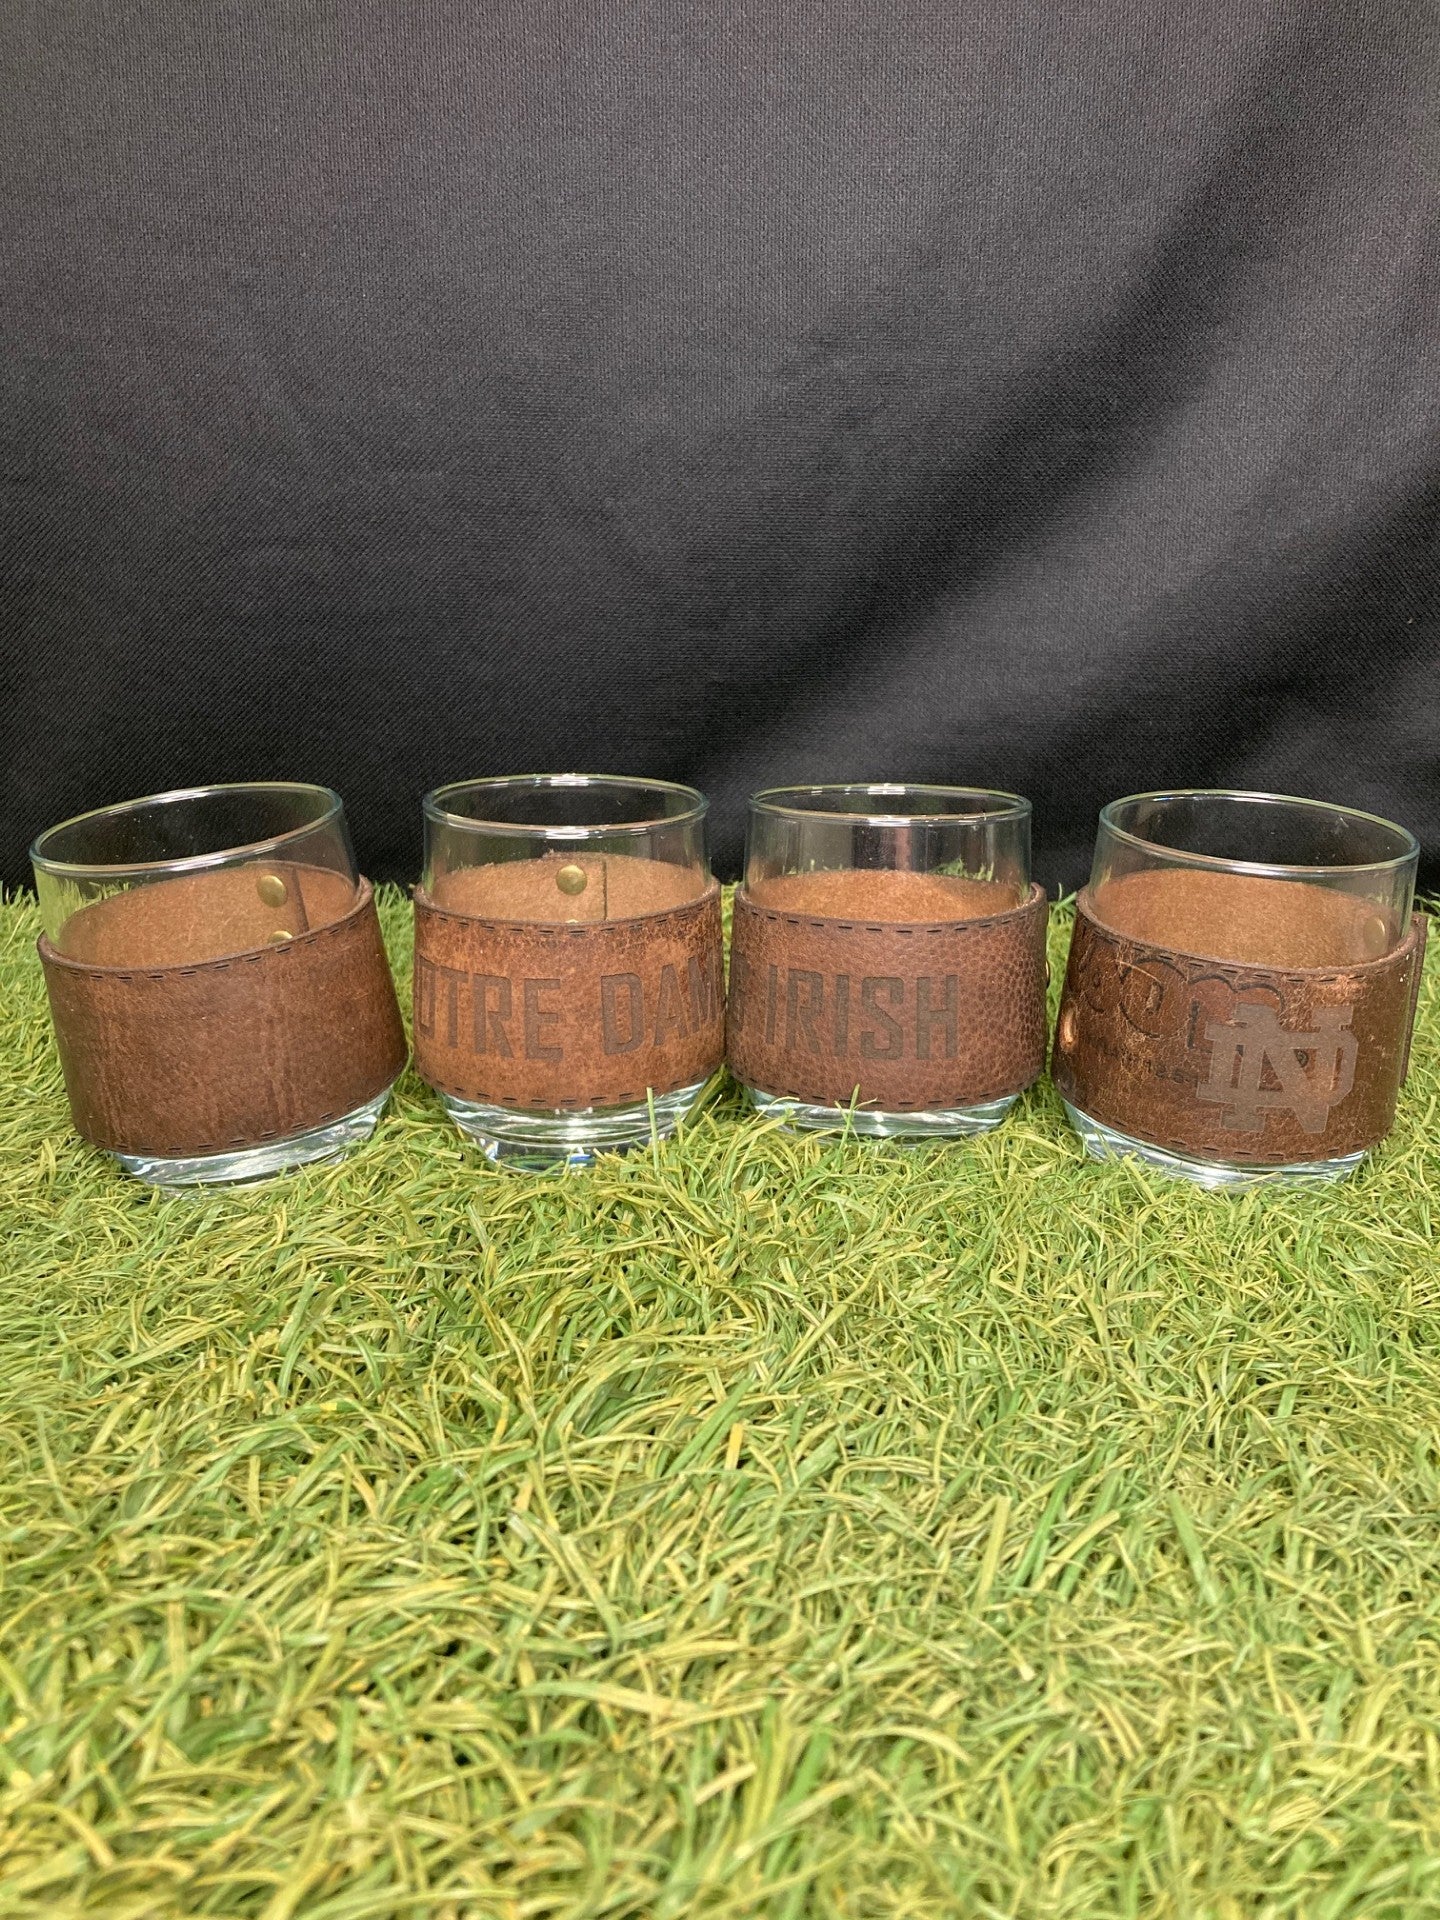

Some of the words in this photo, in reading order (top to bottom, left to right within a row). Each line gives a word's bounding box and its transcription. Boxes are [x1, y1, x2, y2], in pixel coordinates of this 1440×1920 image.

[417, 954, 563, 1061] OTRE
[600, 952, 718, 1055] DAM
[765, 964, 959, 1060] IRISH
